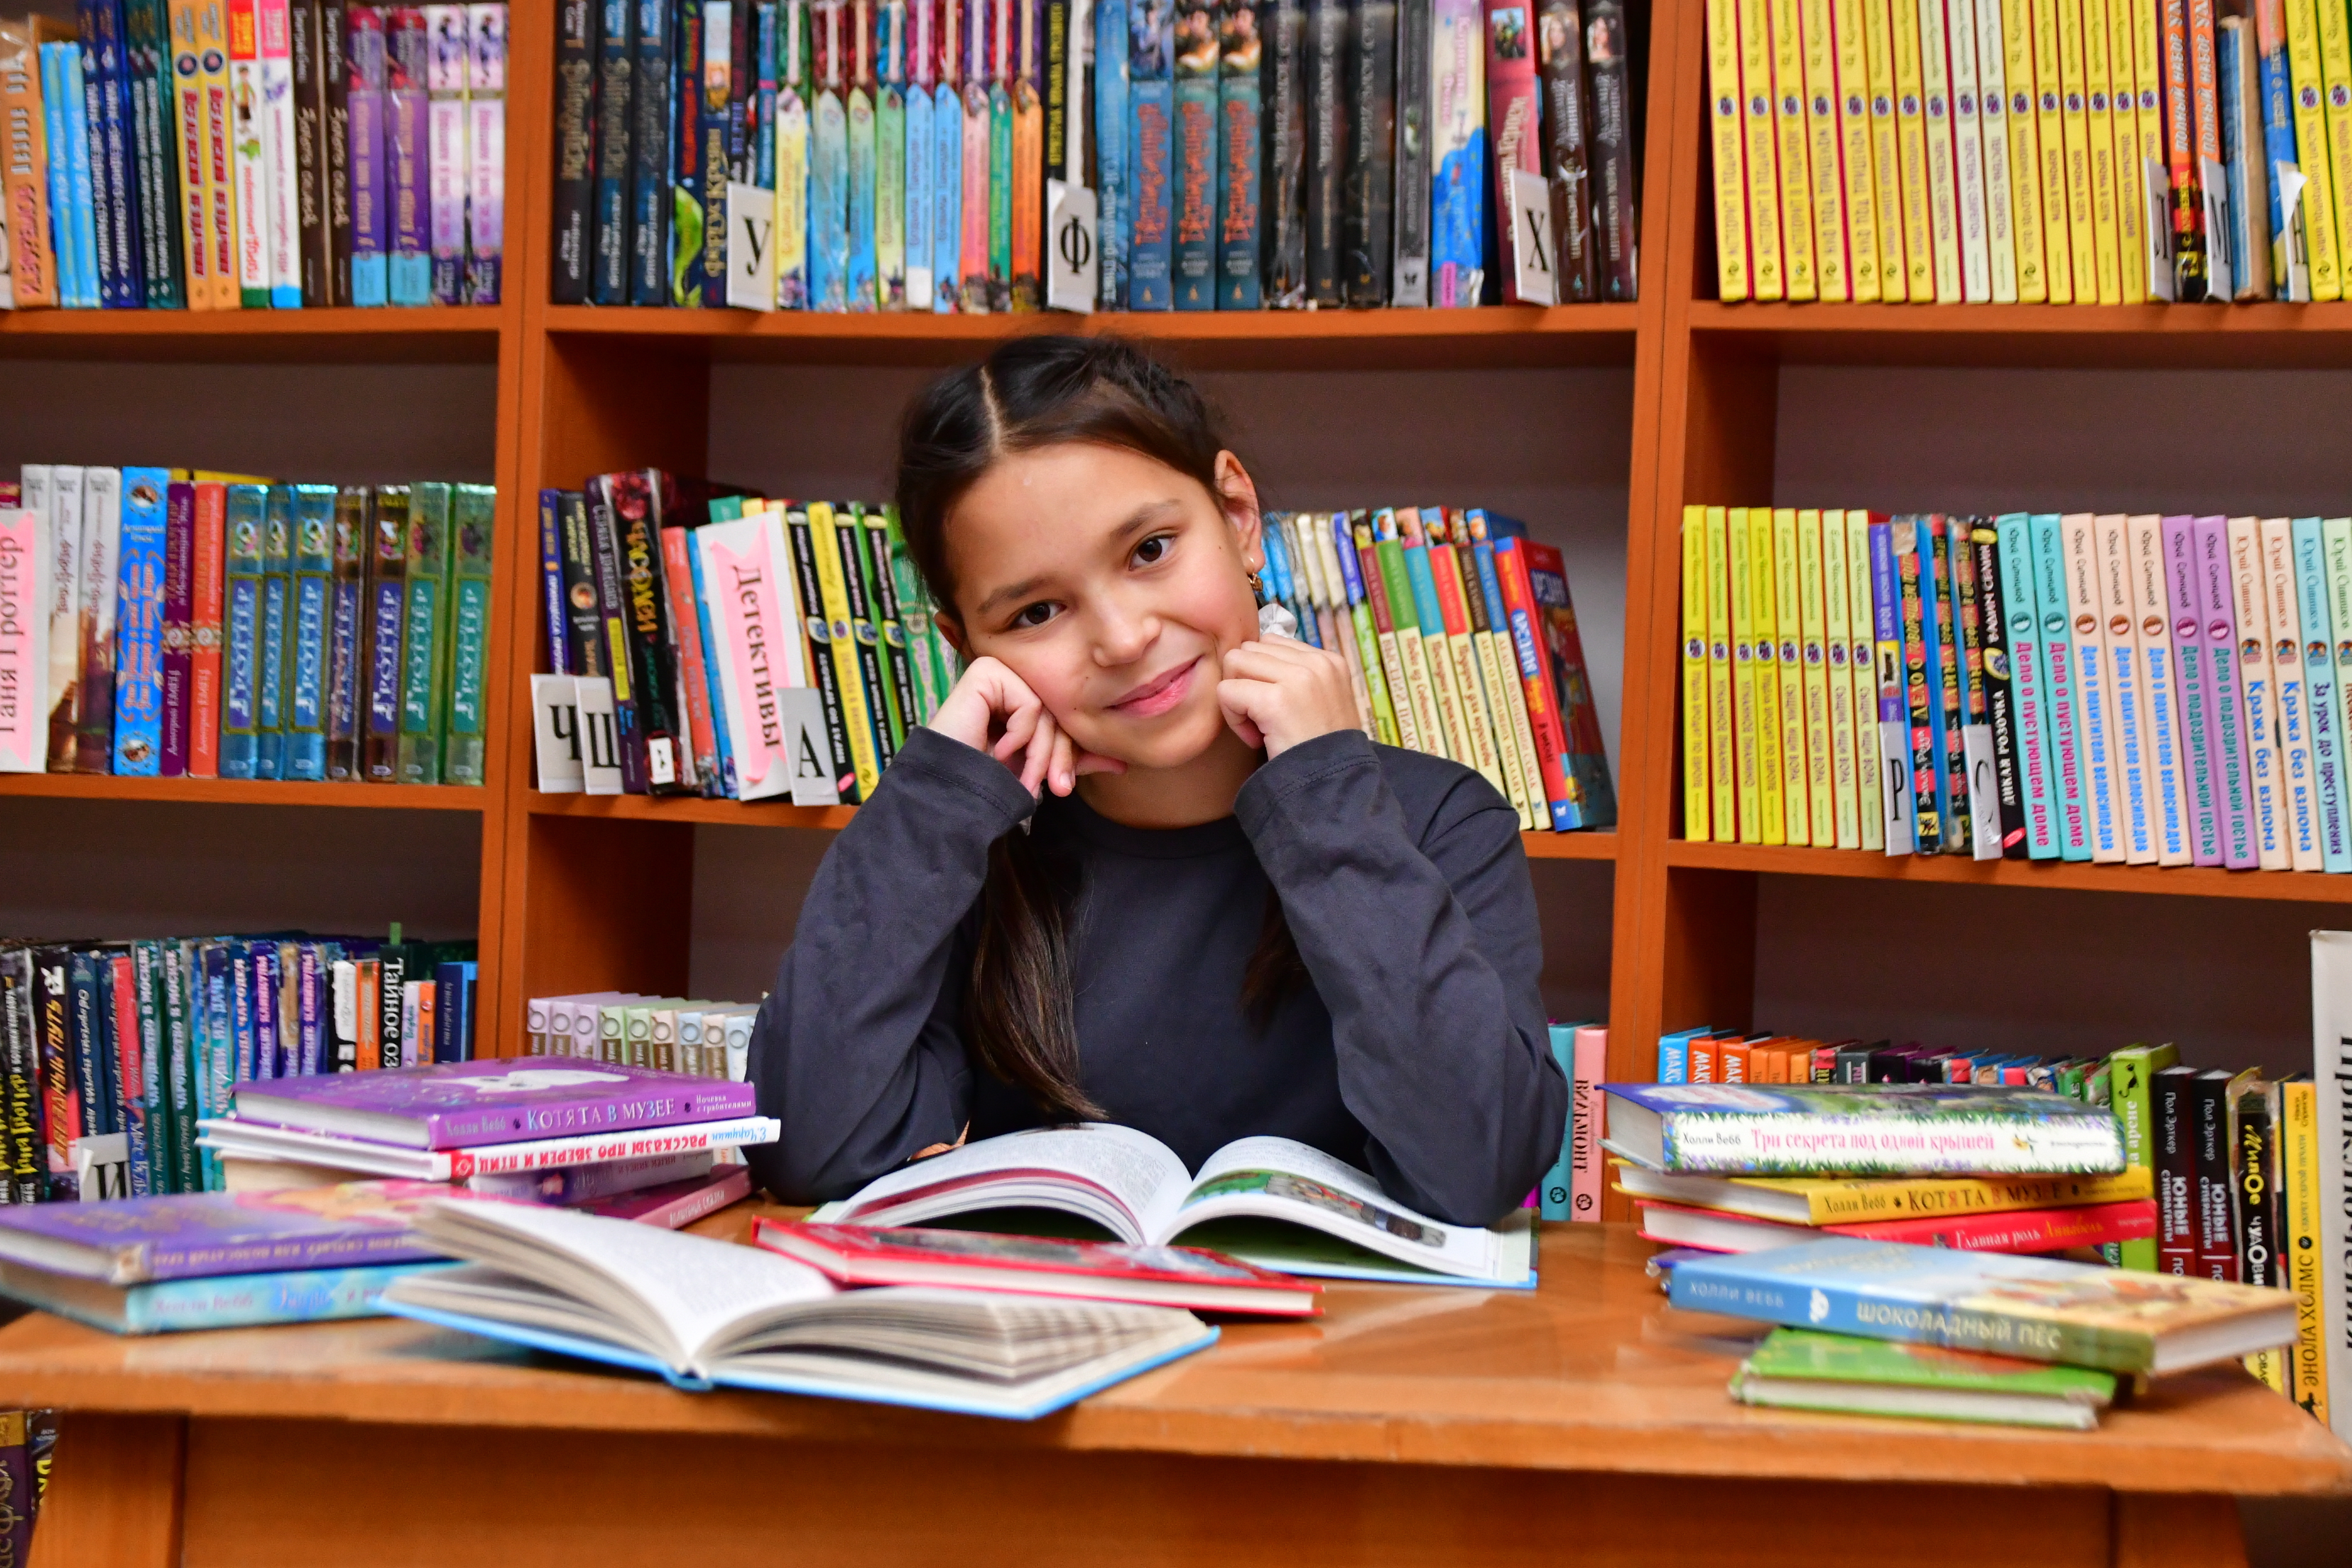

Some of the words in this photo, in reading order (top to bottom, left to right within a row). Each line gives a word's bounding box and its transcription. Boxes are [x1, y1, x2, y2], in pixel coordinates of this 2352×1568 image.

[2170, 33, 2185, 81] НАБОР
[2197, 33, 2212, 83] НАБОР
[2170, 87, 2189, 152] ПОЛНЫЙ
[2198, 87, 2216, 152] ПОЛНЫЙ
[743, 217, 769, 276] У
[1060, 215, 1090, 274] Ф
[1525, 207, 1548, 273] Х
[1979, 544, 1994, 591] СЕЛИН
[2009, 527, 2022, 554] Юрий
[2043, 528, 2055, 554] Юрий
[2074, 529, 2087, 555] Юрий
[547, 575, 562, 635] ПРИНЦЕССА
[2011, 558, 2025, 603] Ситников
[2046, 558, 2059, 604] Ситников
[2078, 559, 2090, 605] Ситников
[1984, 593, 1999, 643] ВАДИМ
[732, 565, 781, 749] Детективы
[2015, 642, 2034, 684] Дело
[2049, 642, 2069, 684] Дело
[2081, 645, 2099, 677] Дело
[2021, 688, 2034, 696] о
[2056, 688, 2069, 697] о
[2247, 680, 2266, 741] Кража
[2281, 681, 2302, 742] Кража
[2314, 681, 2330, 697] За
[547, 705, 582, 760] Ч
[1993, 689, 2010, 754] РОЗОЧКА
[2087, 691, 2107, 763] похитителе
[2120, 692, 2140, 764] похитителе
[2155, 693, 2175, 765] похитителе
[2314, 703, 2332, 734] урок
[798, 721, 825, 778] А
[2019, 701, 2046, 801] пустующем
[2052, 702, 2079, 799] пустующем
[2187, 694, 2213, 807] подозрительной
[2201, 810, 2216, 856] гостье
[2220, 696, 2246, 810] подозрительной
[2256, 748, 2271, 777] без
[2292, 748, 2308, 778] без
[2318, 740, 2333, 755] до
[1891, 759, 1904, 821] Р
[1999, 758, 2015, 805] ДИКАЯ
[2093, 766, 2114, 850] велосипедов
[2321, 761, 2344, 854] преступления
[2030, 804, 2050, 846] доме
[2066, 804, 2084, 847] доме
[2127, 768, 2149, 852] велосипедов
[2162, 768, 2182, 853] велосипедов
[2232, 814, 2249, 859] гостье
[2260, 787, 2276, 851] взлома
[2295, 787, 2312, 852] взлома
[137, 947, 153, 1003] МОСКВЕ
[166, 950, 181, 1005] МОСКВЕ
[209, 975, 225, 1013] ДАЧЕ
[256, 955, 270, 1022] КАНИКУЛЫ
[302, 954, 315, 1022] КАНИКУЛЫ
[384, 957, 404, 1039] Тайное
[46, 999, 65, 1051] ПУТЬ
[212, 1017, 225, 1040] НА
[142, 1018, 160, 1108] ЧАРОДЕЙСТВО
[171, 1021, 188, 1110] ЧАРОДЕЙСТВО
[1725, 1054, 1743, 1083] МАК
[527, 1107, 602, 1132] КОТЯТА
[608, 1104, 617, 1122] В
[623, 1097, 676, 1118] МУЗЕЕ
[1573, 1080, 1589, 1173] ВИЛЬМОНТ
[2125, 1101, 2140, 1148] арене
[2164, 1092, 2176, 1114] Пол
[2203, 1098, 2216, 1121] Пол
[1683, 1132, 1713, 1147] Холли
[1716, 1132, 1741, 1146] Вебб
[1752, 1128, 1781, 1153] Три
[1786, 1131, 1847, 1155] секрета
[1851, 1132, 1877, 1150] под
[1881, 1132, 1925, 1152] одной
[1930, 1131, 1994, 1156] крышей
[1907, 1189, 1986, 1212] КОТЯТА
[2161, 1169, 2174, 1242] СУПЕРАГЕНТЫ
[2172, 1177, 2189, 1235] ЮНЫЕ
[2199, 1176, 2213, 1249] СУПЕРАГЕНТЫ
[2211, 1183, 2229, 1242] ЮНЫЕ
[1955, 1227, 2009, 1250] Главная
[2013, 1227, 2041, 1245] роль
[2298, 1254, 2316, 1321] ХОЛМС
[1856, 1300, 2012, 1342] ШОКОЛАДНЫЙ
[2301, 1325, 2318, 1387] ЭНОЛА
